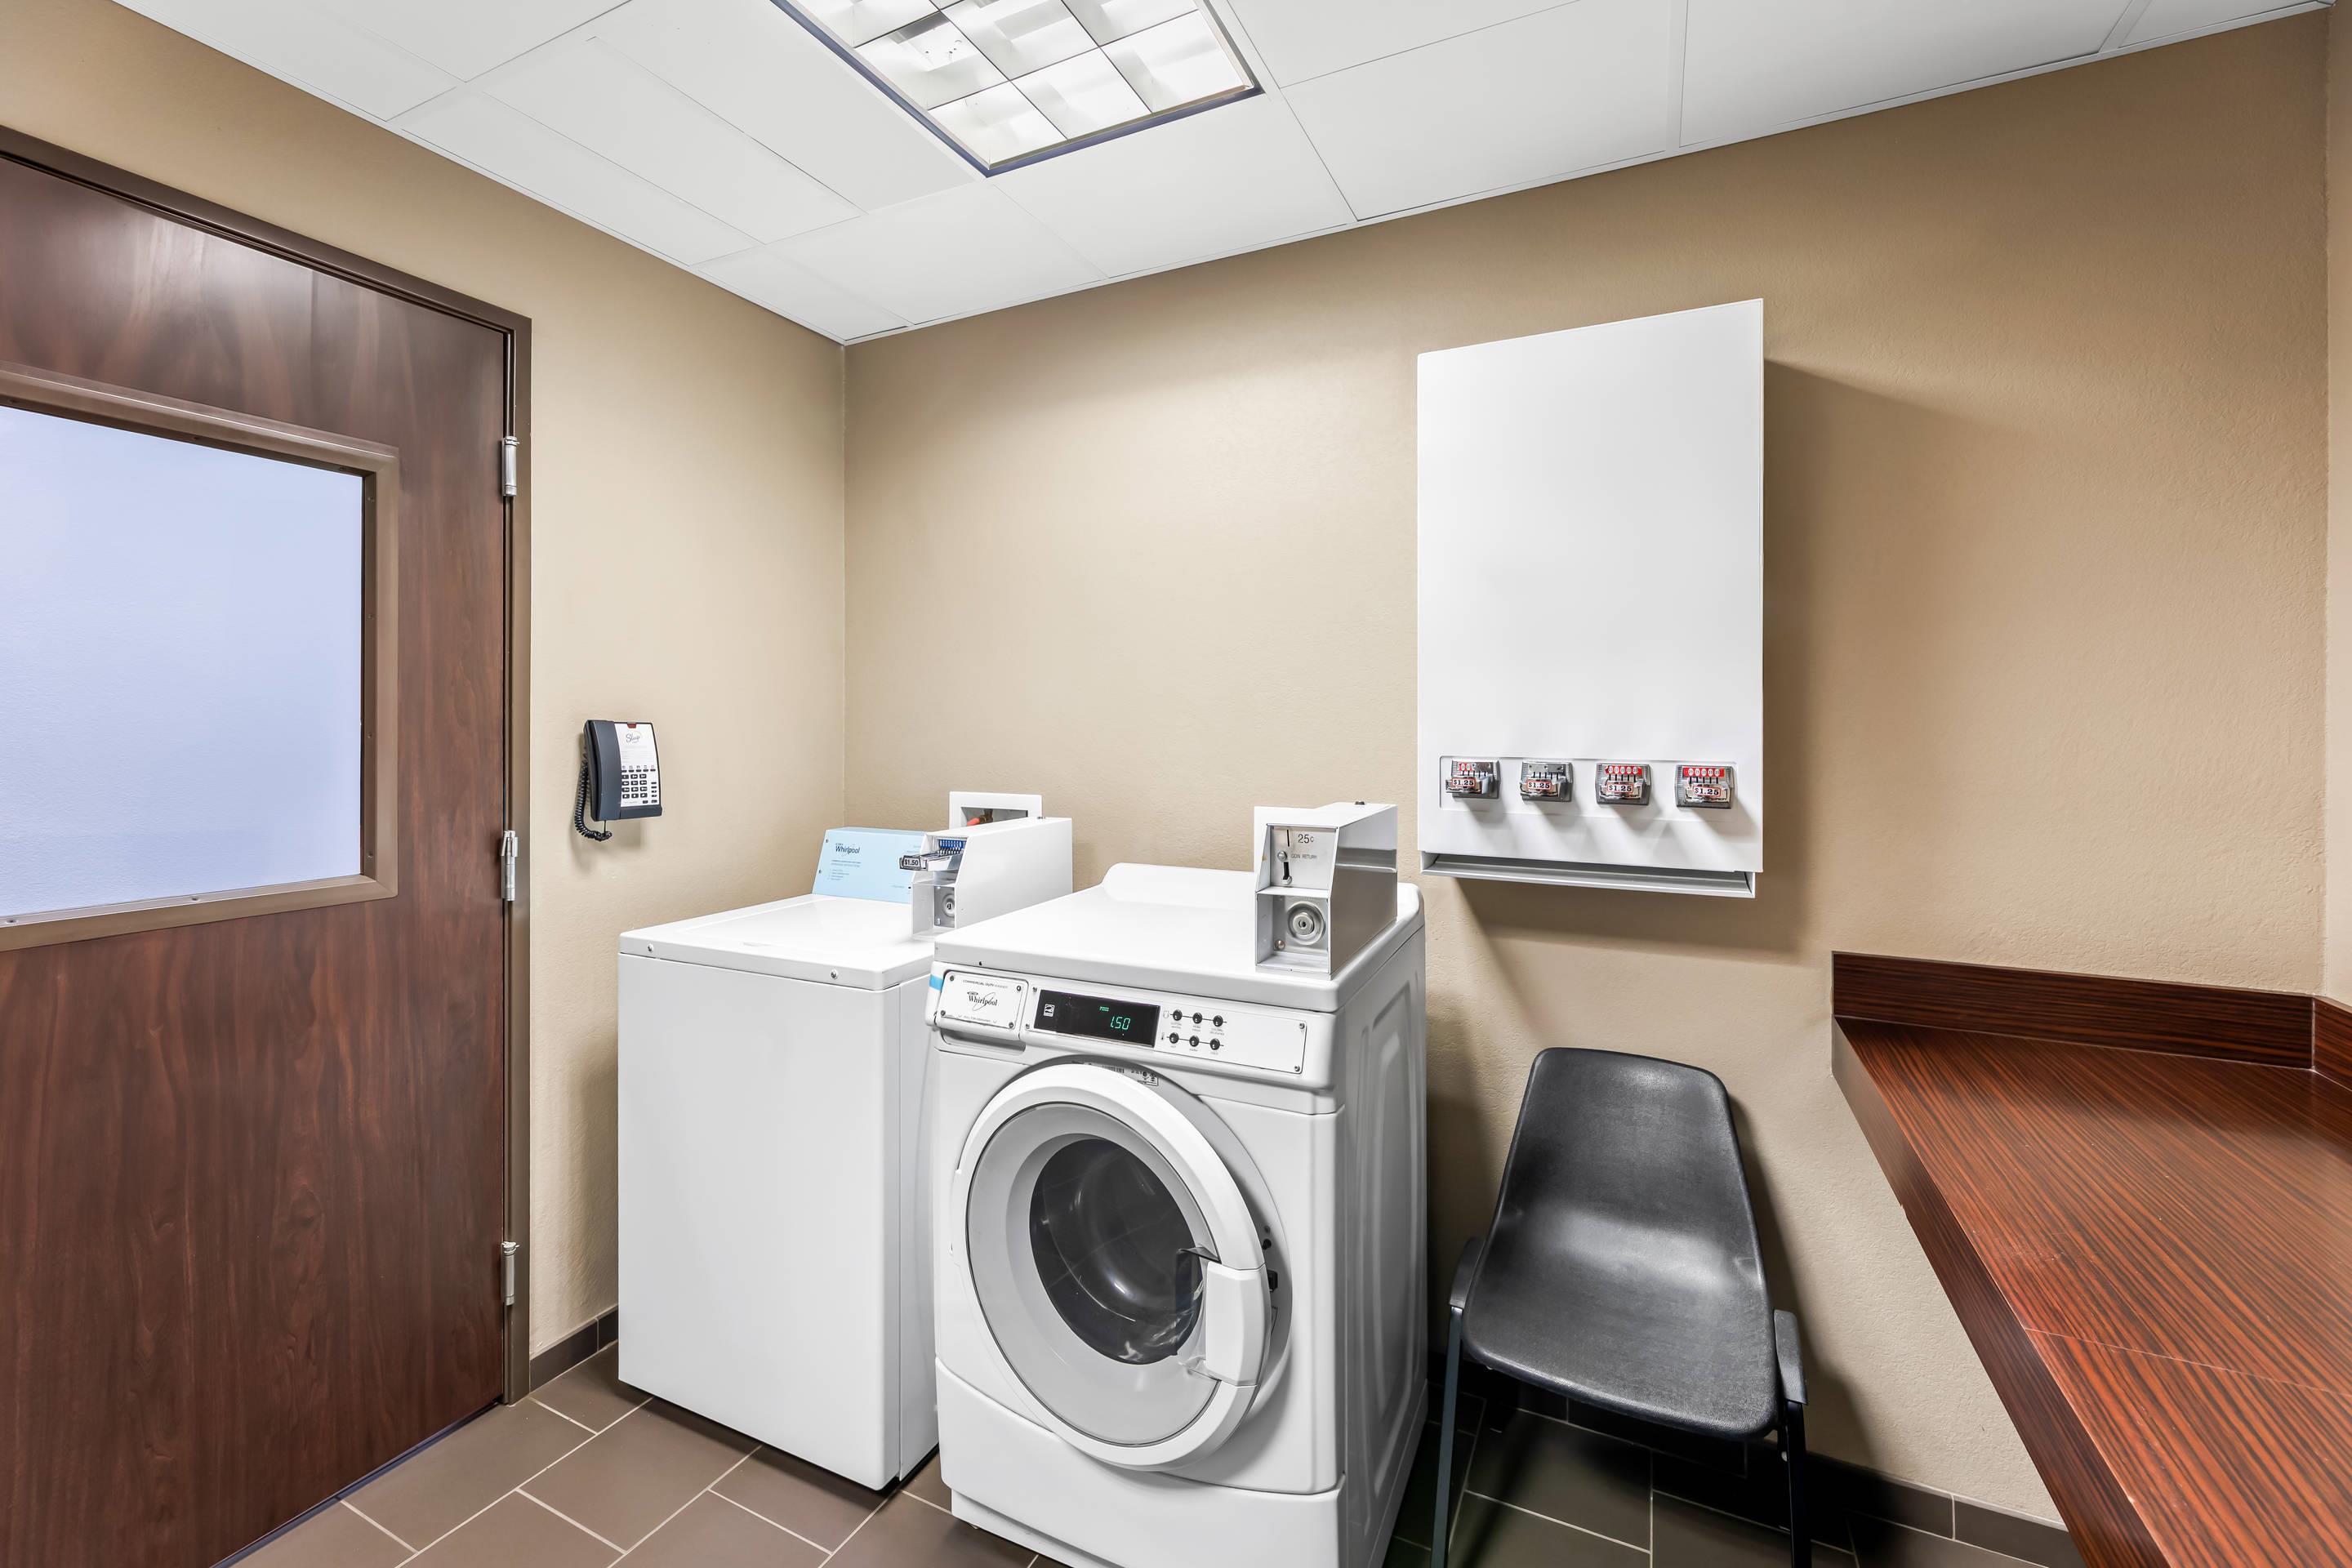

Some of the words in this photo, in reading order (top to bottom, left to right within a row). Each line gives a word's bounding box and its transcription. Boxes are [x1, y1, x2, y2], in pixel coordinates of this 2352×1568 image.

[1694, 787, 1719, 795] $1.25
[1298, 833, 1314, 844] 25¢
[835, 845, 861, 854] Whirlpool
[969, 995, 998, 1006] Whirlpool
[1111, 1016, 1131, 1030] 1.50
